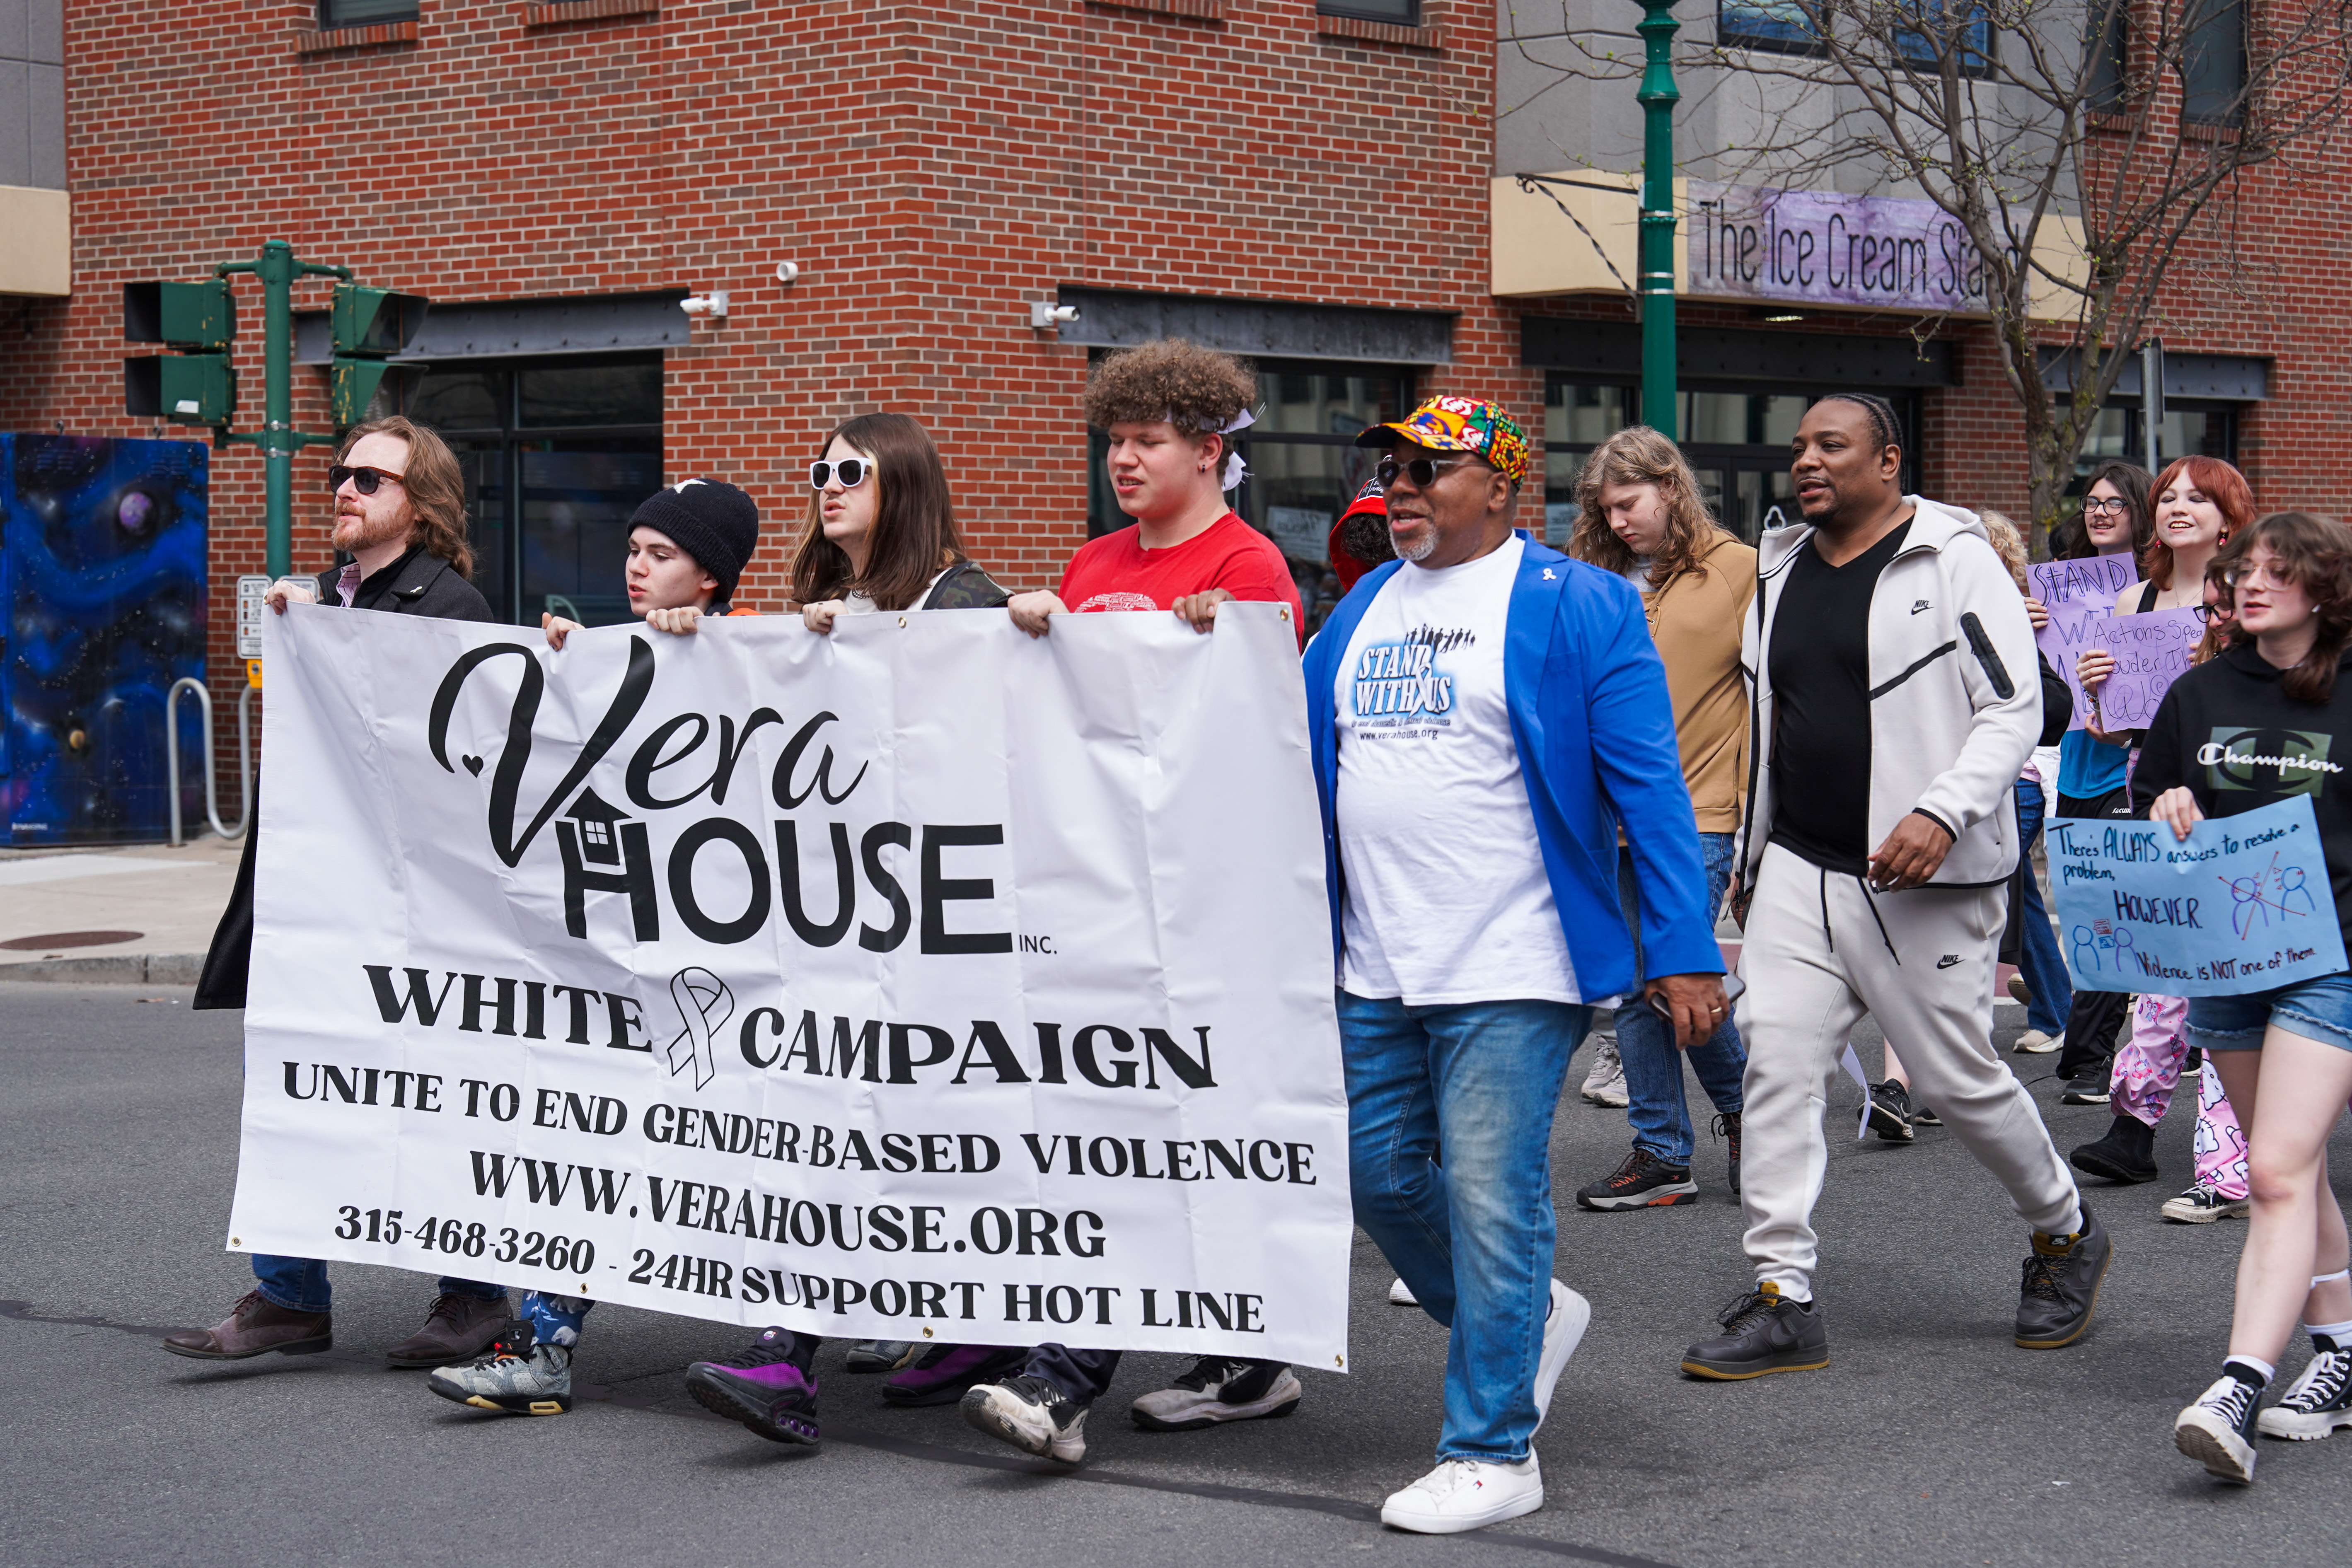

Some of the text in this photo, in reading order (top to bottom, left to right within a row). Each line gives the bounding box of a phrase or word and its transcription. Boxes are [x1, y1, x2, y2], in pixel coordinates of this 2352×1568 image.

[1699, 199, 2019, 297] The Ice Cream Stad
[2034, 559, 2127, 607] STAND
[1913, 600, 1929, 609] NIKE
[2093, 621, 2166, 649] Actions
[2168, 619, 2203, 643] Spea
[1358, 644, 1433, 680] STAND
[2111, 650, 2160, 675] ouder
[1355, 676, 1451, 715] WITH US
[428, 634, 869, 868] Vera
[1359, 730, 1438, 741] www.verahouse.org
[2197, 742, 2344, 776] Champion
[2167, 848, 2218, 863] answers
[2221, 834, 2239, 855] to
[554, 817, 1057, 955] HOUSE INC.
[1941, 954, 1959, 963] NIKE
[2136, 951, 2194, 980] Violence
[2196, 962, 2209, 980] is
[2210, 958, 2237, 979] NOT
[2240, 962, 2265, 976] one
[2267, 951, 2282, 969] of
[362, 964, 1218, 1090] WHITE CAMPAIGN
[283, 1061, 1317, 1186] UNITE TO END GENDER-BASED VIOLENCE
[469, 1150, 1107, 1263] WWW.VERAHOUSE.ORG
[335, 1206, 595, 1274] 315-468-3260
[628, 1249, 733, 1299] 24HR
[742, 1266, 985, 1320] SUPPORT
[1003, 1284, 1121, 1325] HOT
[1140, 1289, 1265, 1334] LINE
